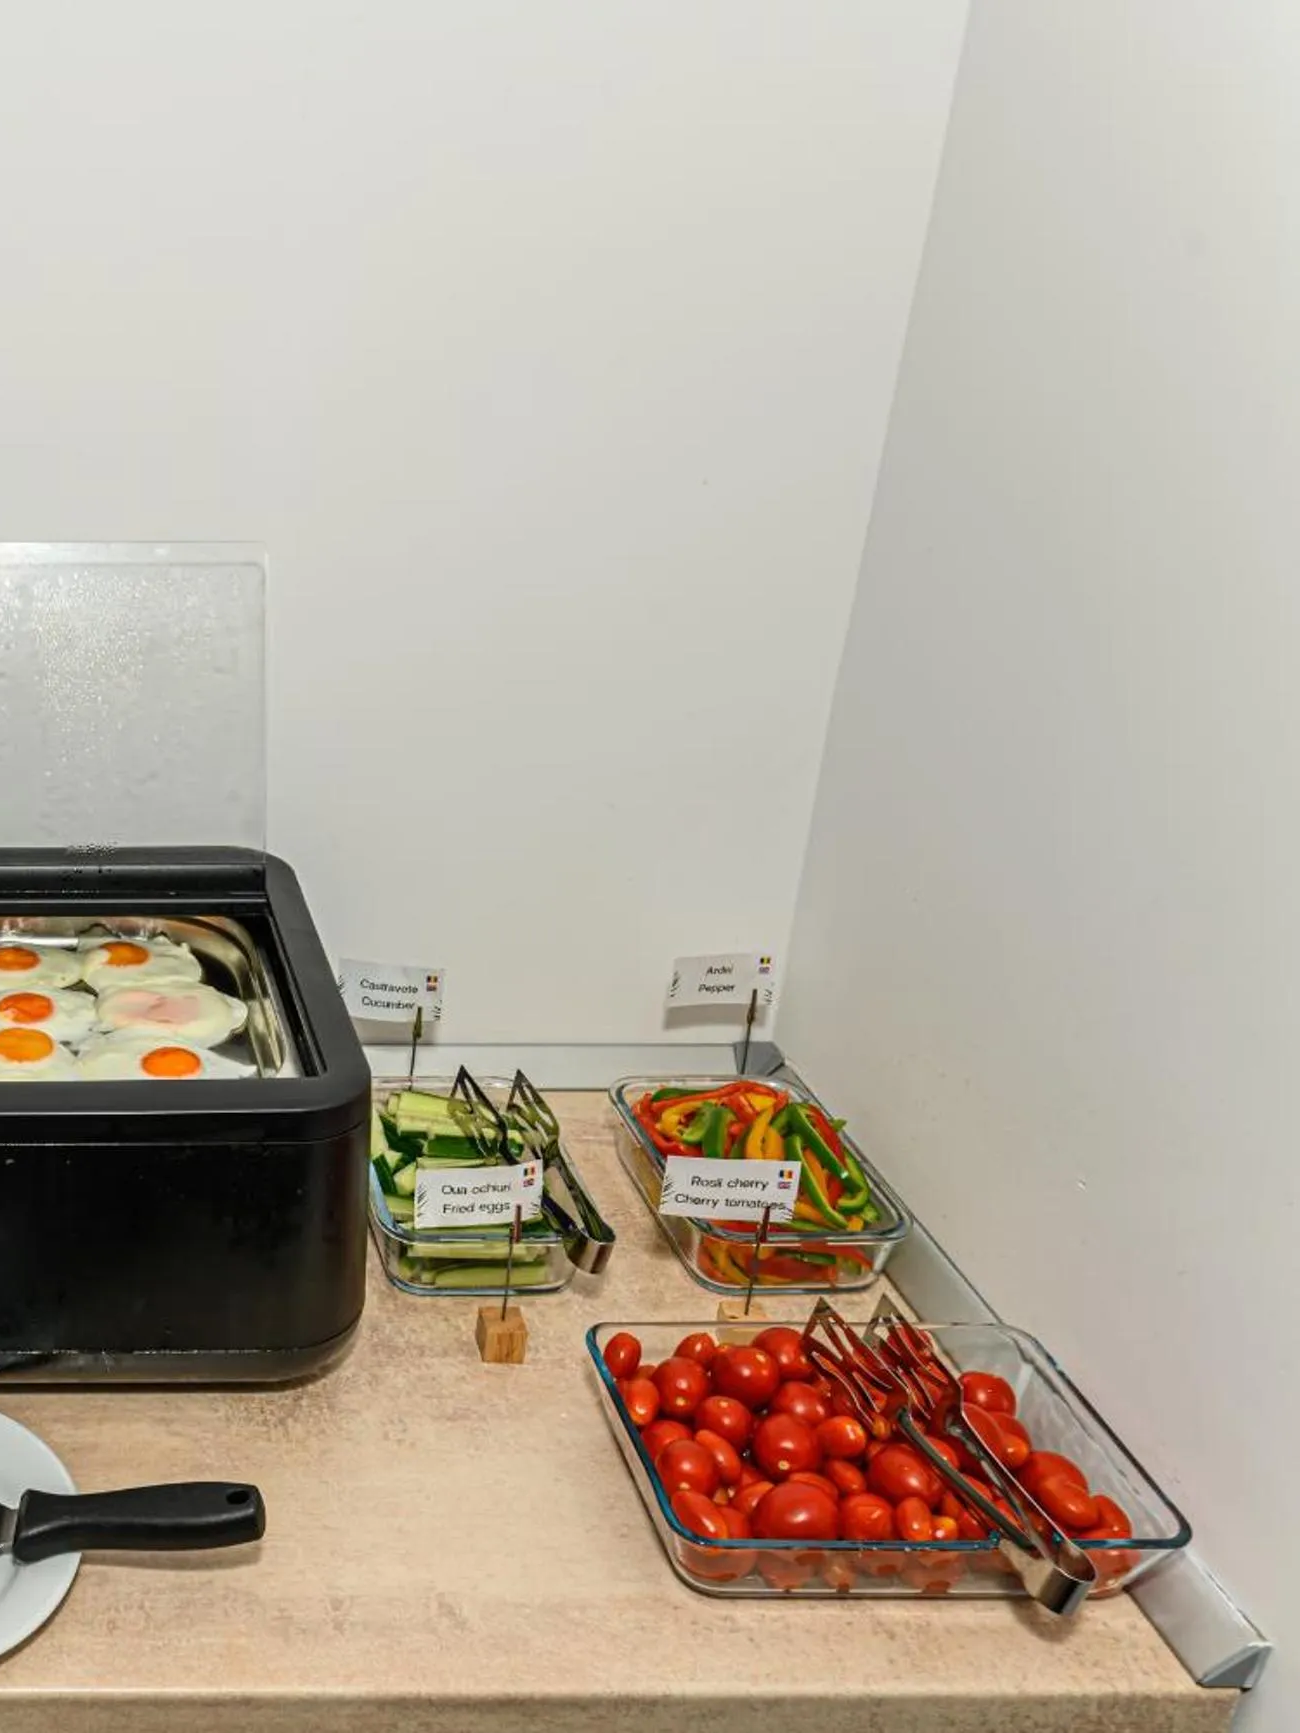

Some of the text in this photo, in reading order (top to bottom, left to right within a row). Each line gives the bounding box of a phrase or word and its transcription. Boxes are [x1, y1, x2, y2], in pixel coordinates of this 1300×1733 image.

[698, 983, 736, 995] Pepper
[361, 995, 415, 1010] Cucumber
[726, 1178, 770, 1192] cherry
[442, 1201, 511, 1215] Fried eggs
[674, 1193, 787, 1210] Cherry tomatoes
